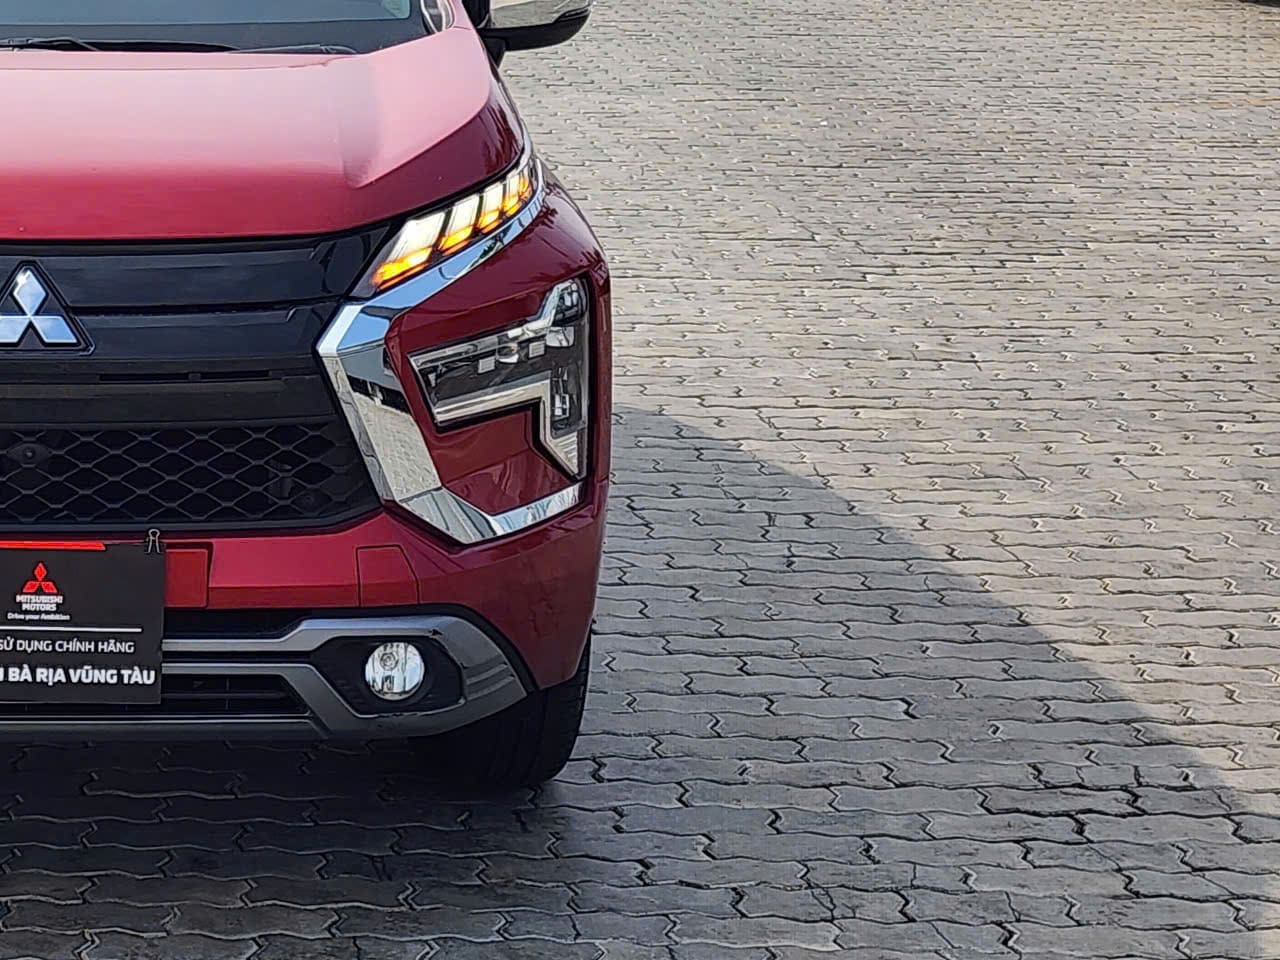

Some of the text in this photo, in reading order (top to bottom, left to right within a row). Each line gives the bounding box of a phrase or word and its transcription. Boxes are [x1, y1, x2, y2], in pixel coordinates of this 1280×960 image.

[15, 594, 64, 604] MITSUBISHI
[22, 603, 57, 611] MOTORS
[17, 639, 52, 654] DỤNG
[55, 637, 95, 653] CHÍNH
[98, 638, 135, 654] HÃNG
[8, 665, 31, 683] BÀ
[36, 667, 67, 686] RỊA
[70, 665, 118, 684] VŨNG
[121, 665, 156, 685] TÀU
